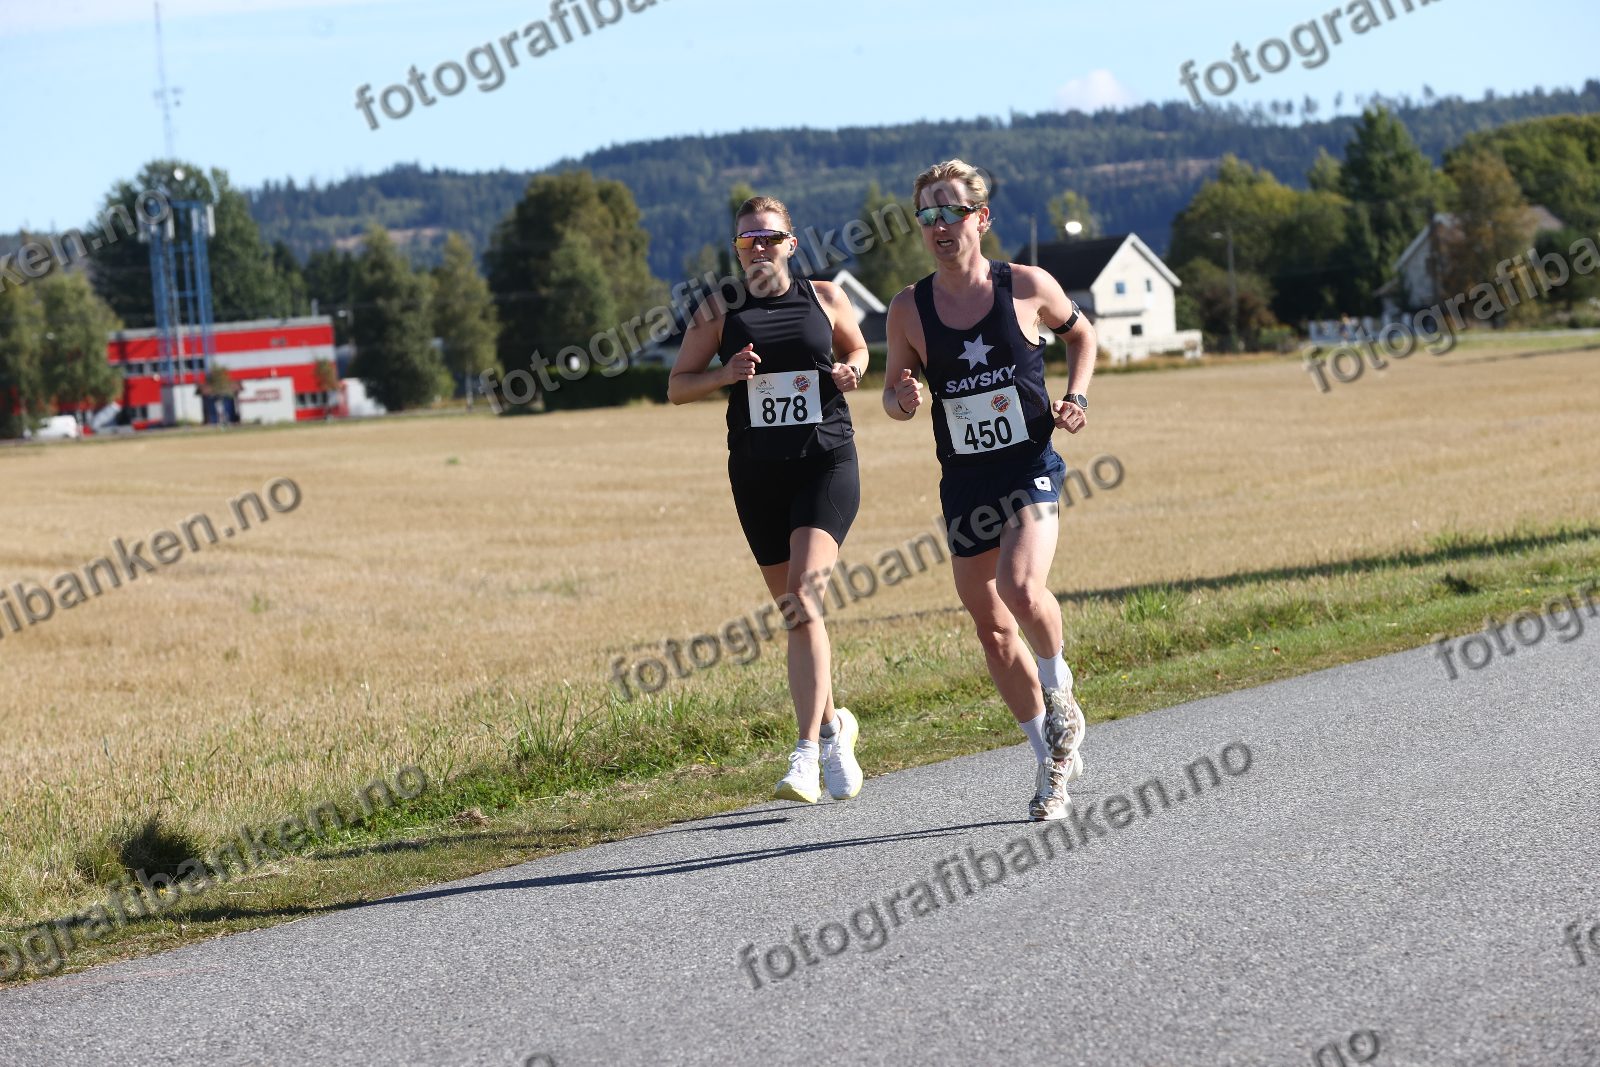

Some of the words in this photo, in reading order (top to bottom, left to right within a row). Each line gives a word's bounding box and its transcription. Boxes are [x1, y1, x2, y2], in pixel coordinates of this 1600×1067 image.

[945, 366, 1014, 394] SAYSKY
[762, 395, 808, 424] 878
[964, 416, 1012, 450] 450
